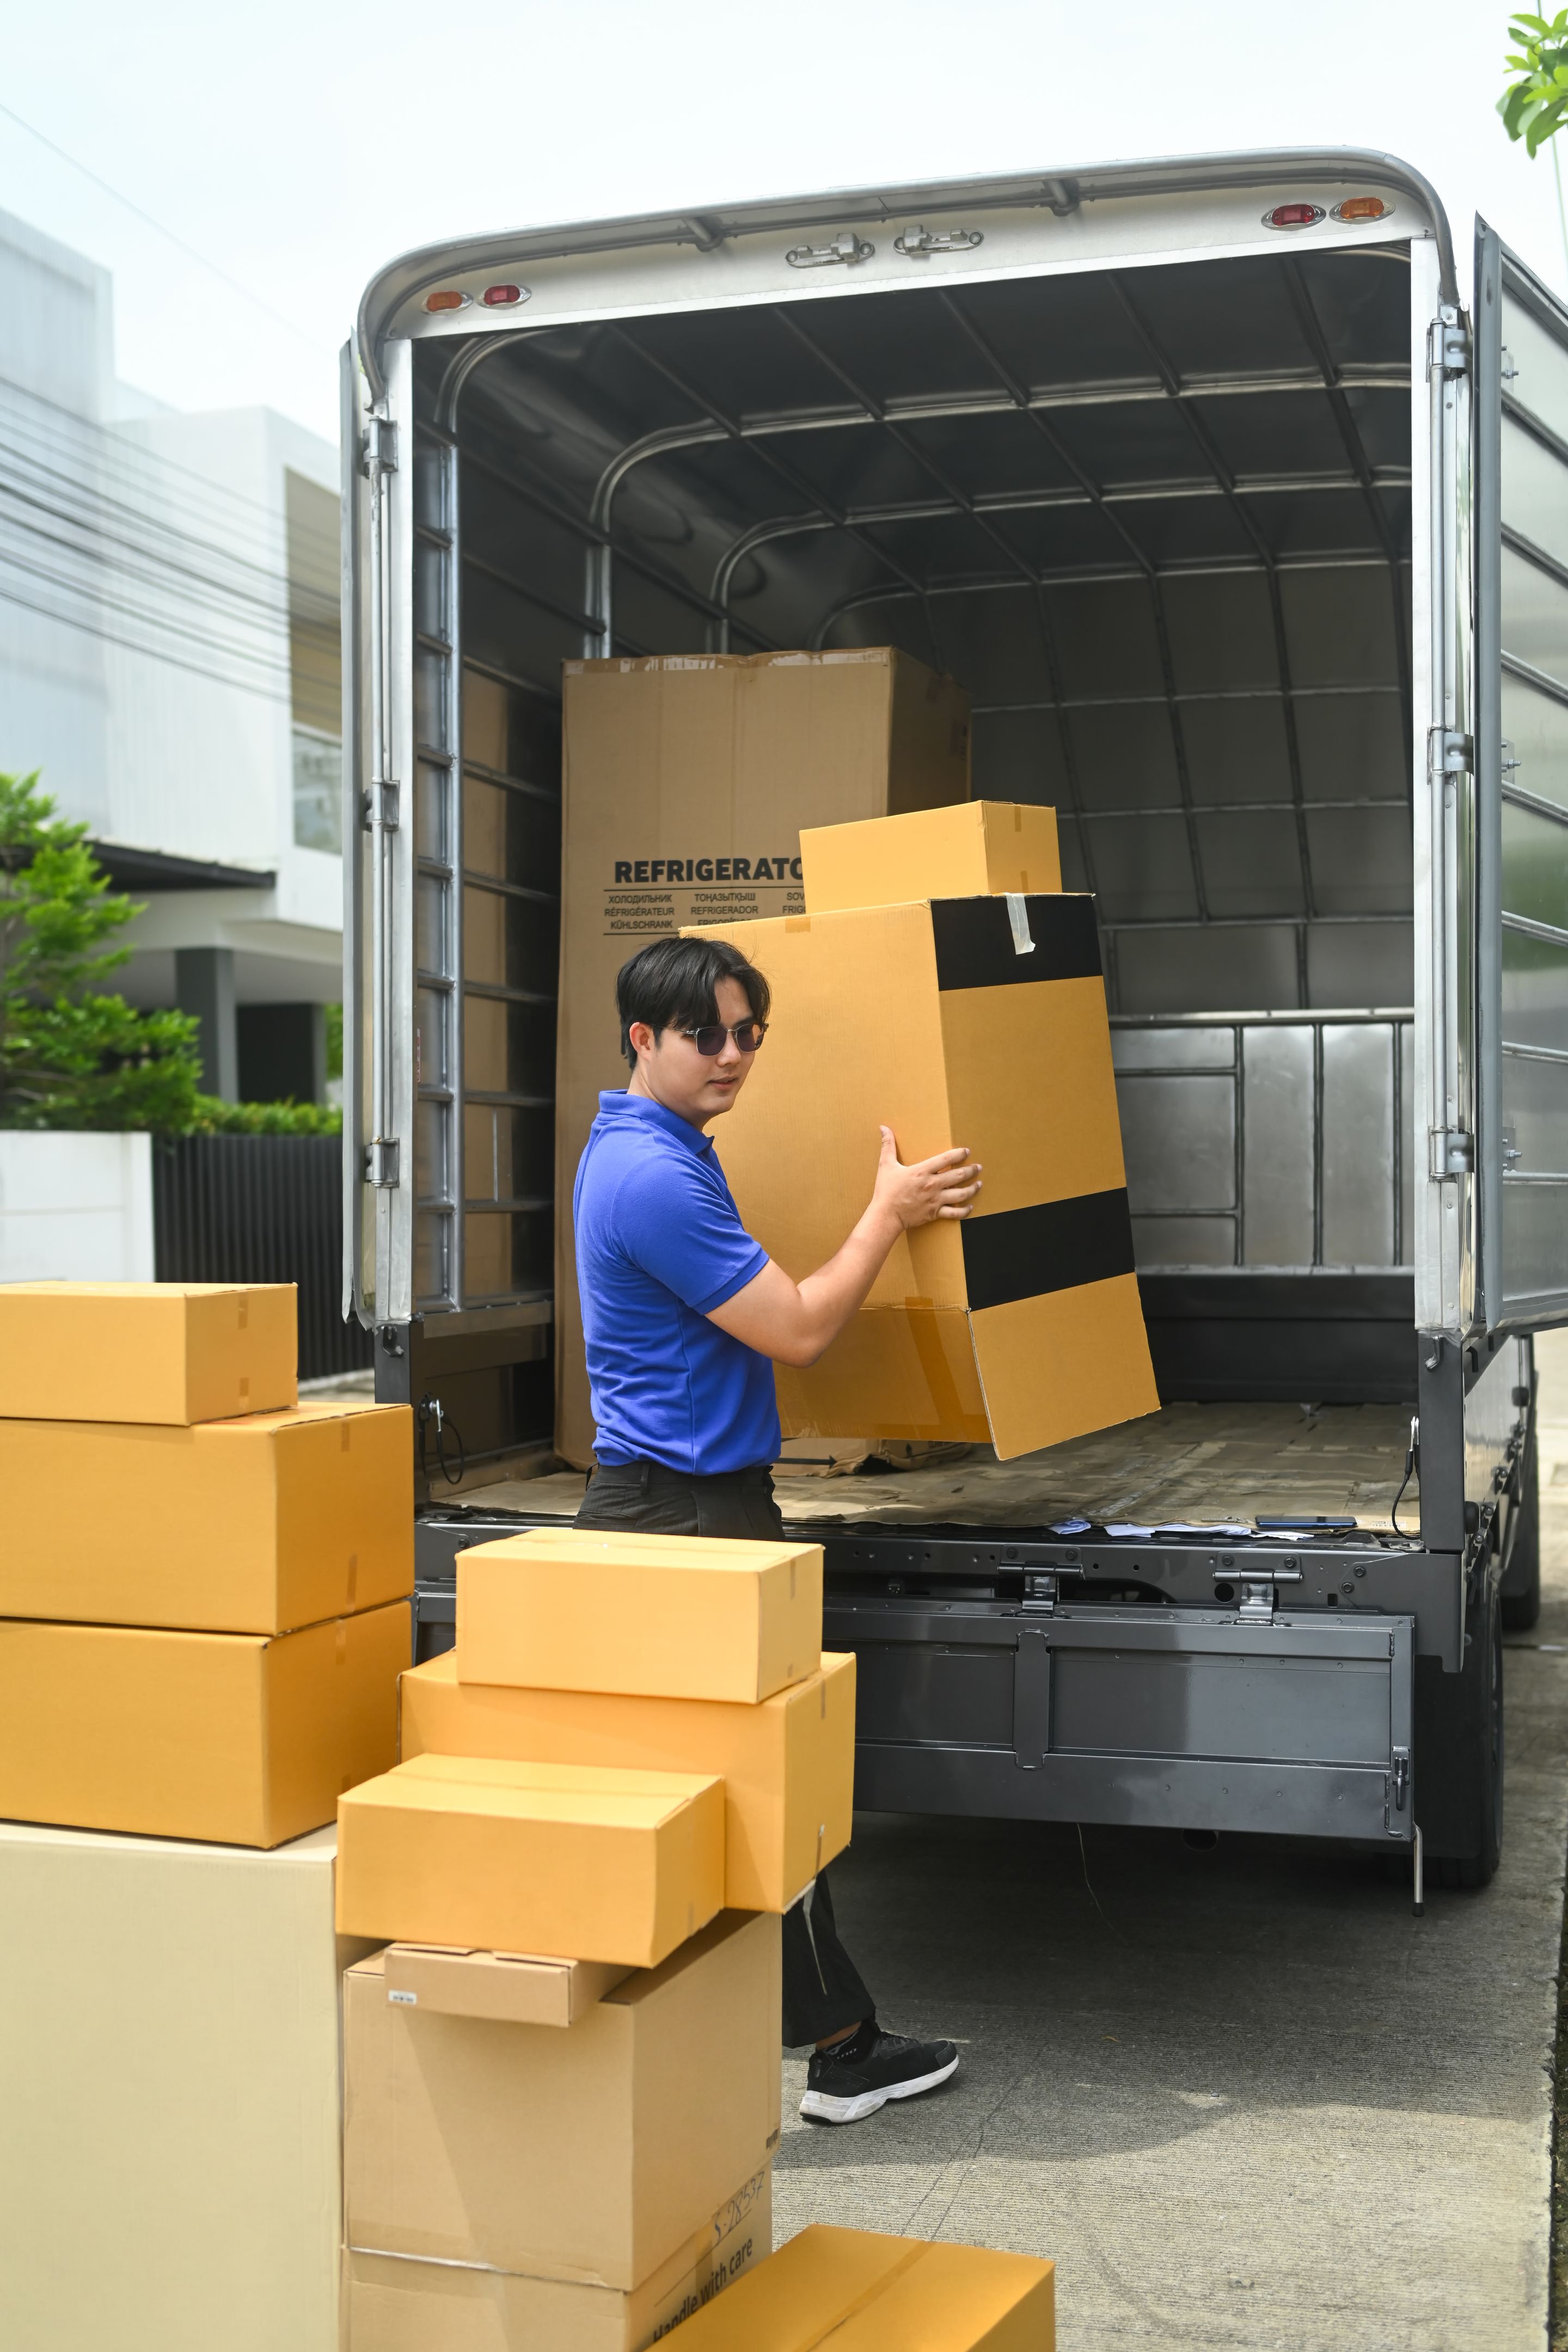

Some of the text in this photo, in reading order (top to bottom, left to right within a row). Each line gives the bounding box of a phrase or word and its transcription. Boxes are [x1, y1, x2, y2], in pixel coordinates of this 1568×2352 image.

[609, 894, 672, 904] ХОЛОДИЛЬНИК
[694, 892, 756, 903] ТОҢАЗЫТҚЫШ
[604, 906, 675, 916] RÉFRIGÉRATEUR
[690, 906, 758, 915] REFRIGERADOR
[611, 920, 673, 929] KÜHLSCHRANK
[700, 2262, 726, 2306] with
[729, 2238, 752, 2275] care
